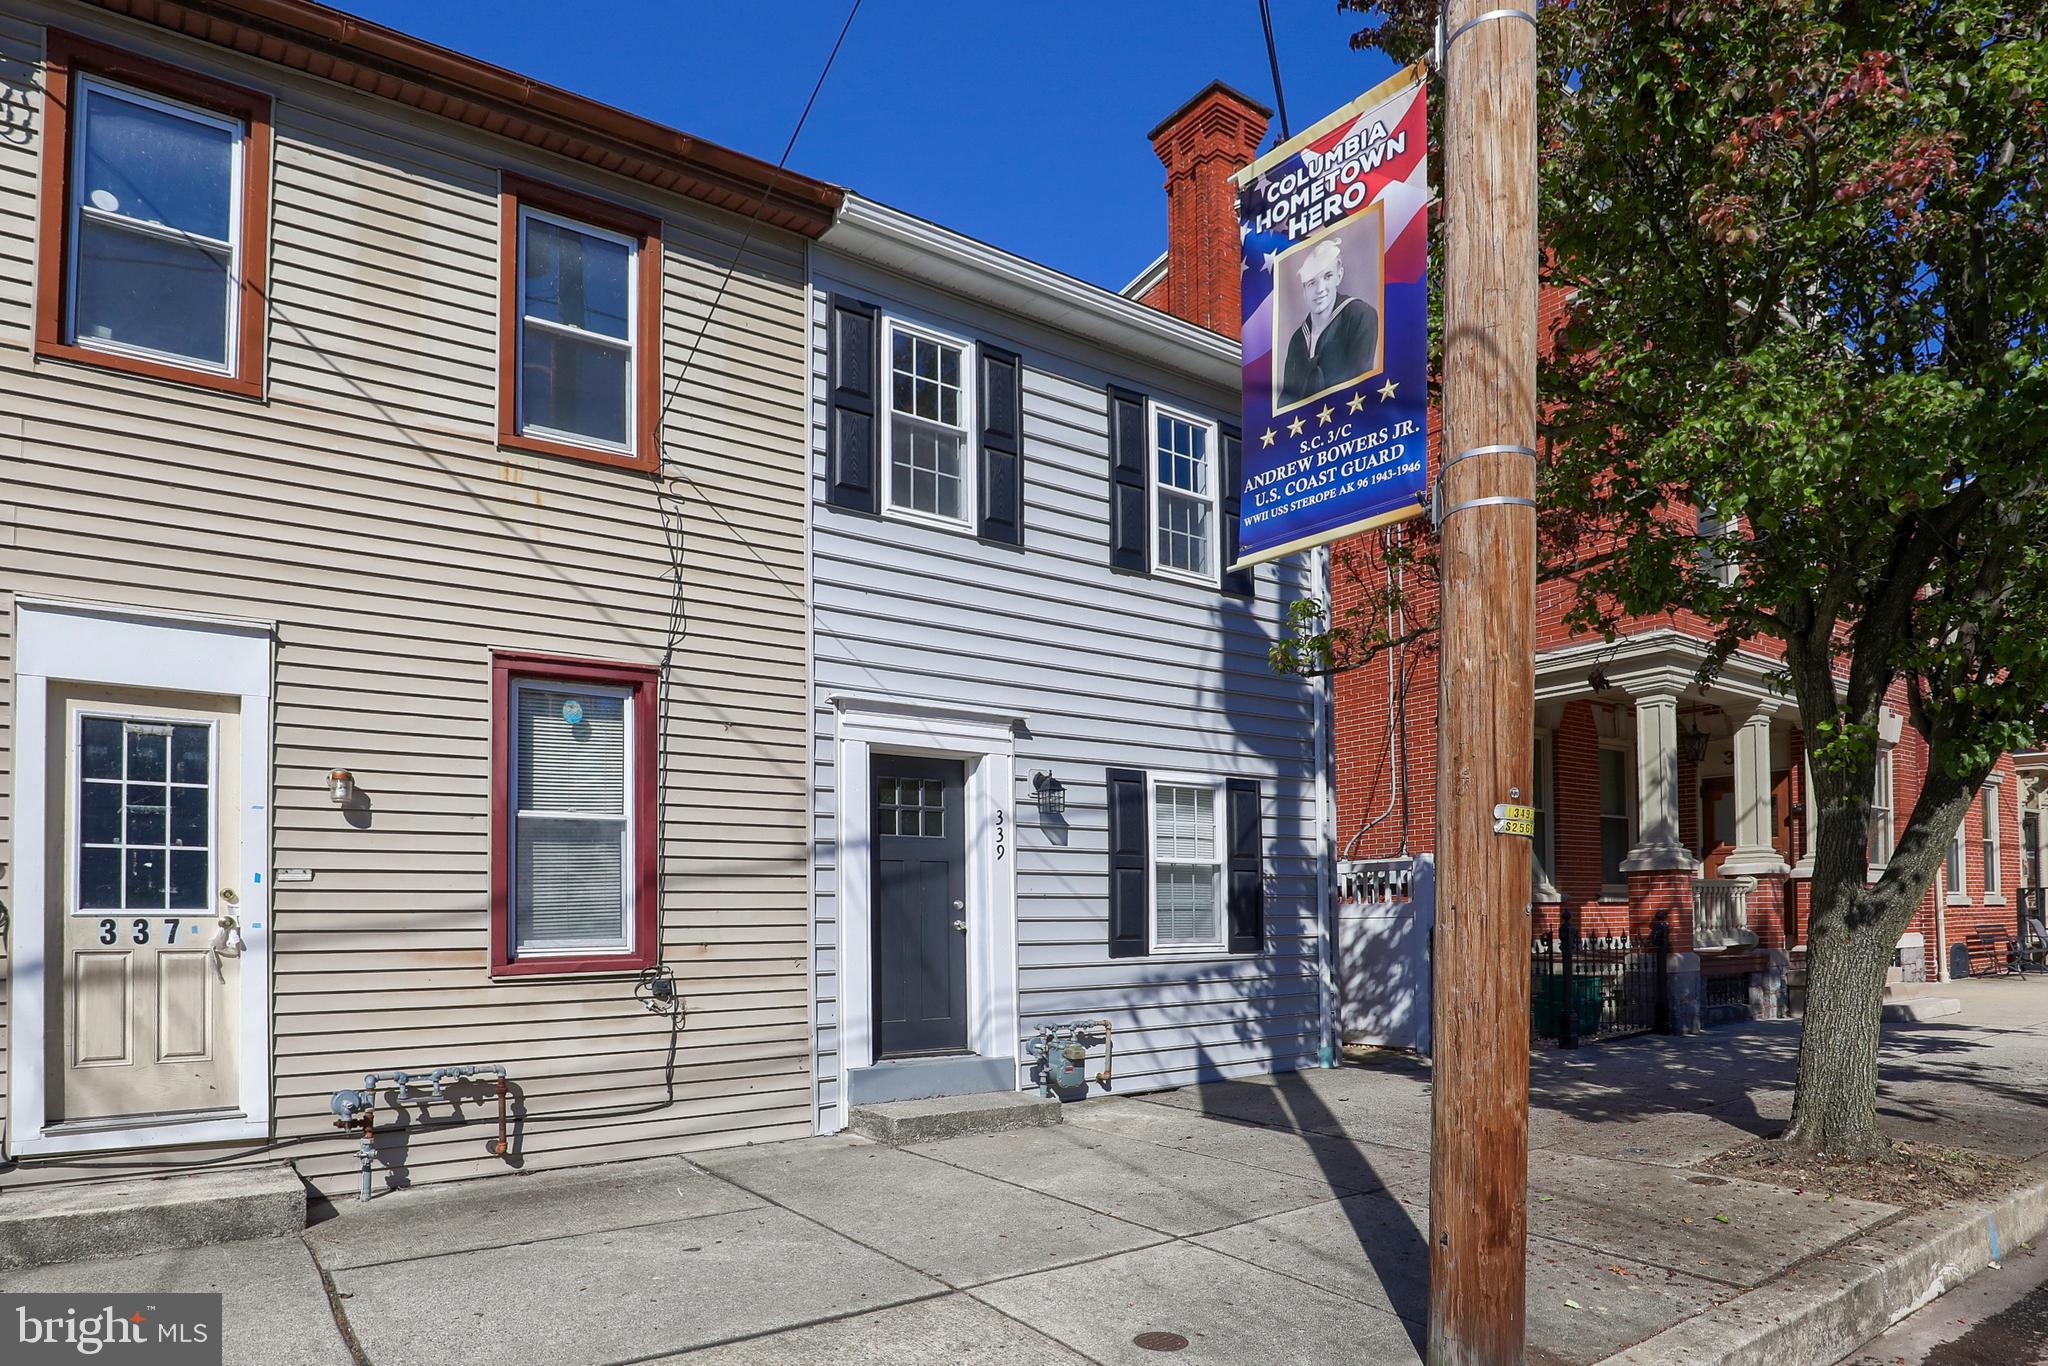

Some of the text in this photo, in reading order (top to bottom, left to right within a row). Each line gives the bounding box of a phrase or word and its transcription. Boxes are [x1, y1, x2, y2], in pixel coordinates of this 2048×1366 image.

[1256, 131, 1405, 234] HOMETOWN
[1267, 120, 1387, 202] COLUMBIA
[1288, 181, 1366, 240] HERO
[1244, 420, 1420, 494] ANDREW BOWERS JR.
[1300, 423, 1352, 454] S.C. 3/C
[1244, 460, 1421, 527] WWII USS STEROPE AK 96 1943-1946
[1255, 444, 1405, 507] U.S. COAST GUARD
[995, 809, 1005, 860] 339
[100, 918, 180, 945] 337
